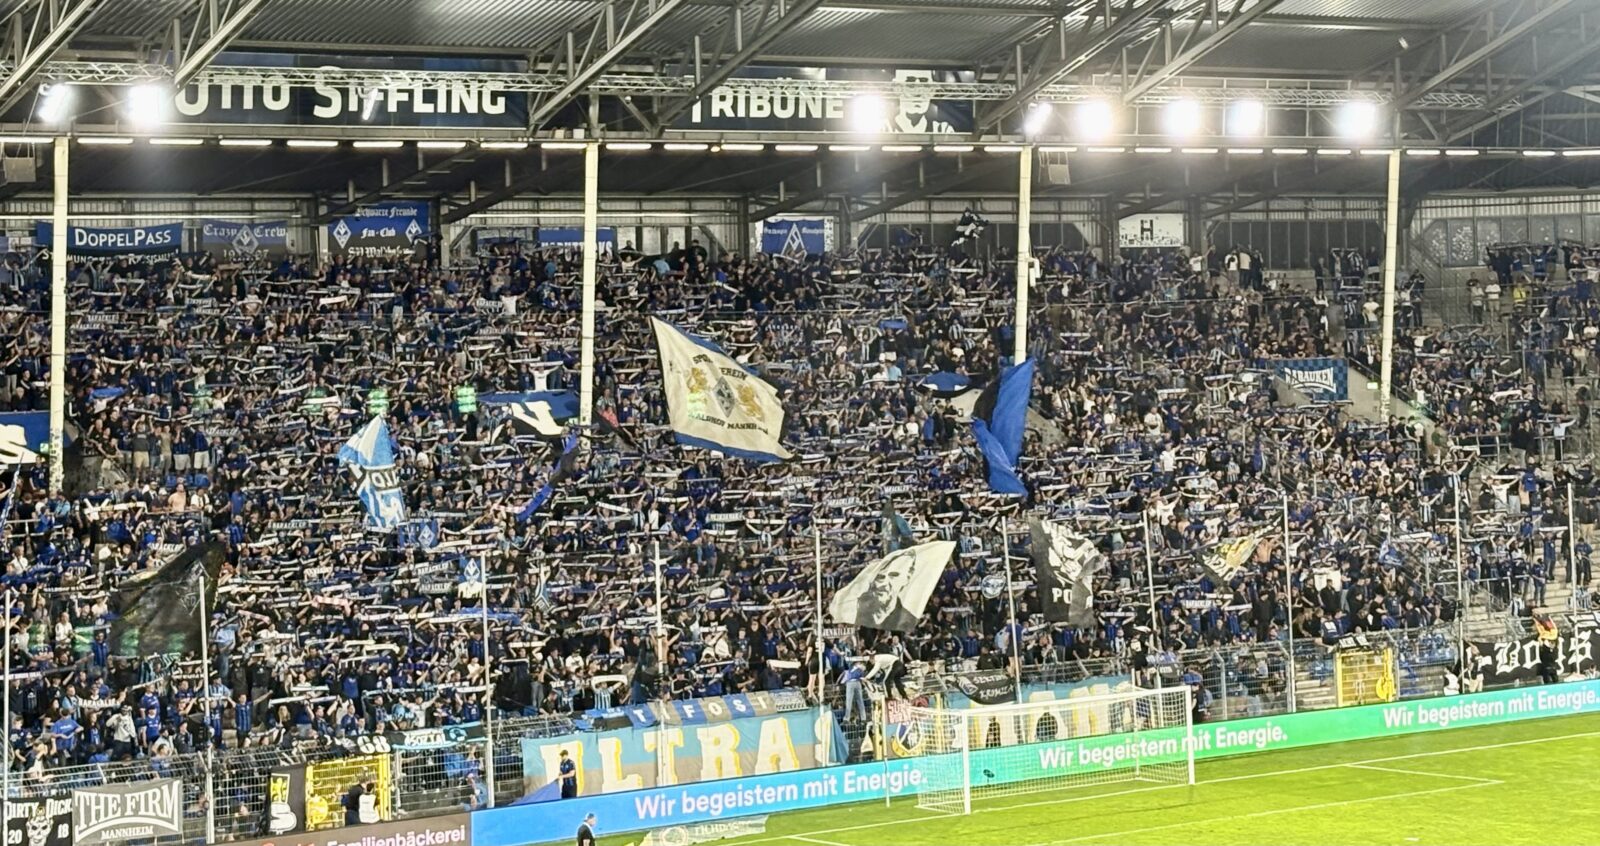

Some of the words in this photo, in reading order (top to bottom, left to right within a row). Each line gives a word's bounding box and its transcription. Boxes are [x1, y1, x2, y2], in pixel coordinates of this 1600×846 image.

[174, 74, 290, 116] OTTO
[203, 224, 238, 240] Crazy
[254, 225, 286, 238] Crew
[1384, 707, 1415, 729] Wir
[1418, 698, 1504, 727] begeistern
[1508, 693, 1535, 711] mit
[1537, 687, 1600, 711] Energie.
[357, 735, 391, 754] 68
[1039, 744, 1074, 769] Wir
[1079, 736, 1178, 768] begeistern
[1182, 731, 1211, 752] mit
[1215, 720, 1289, 748] Energie.
[75, 789, 121, 830] THE
[125, 780, 180, 822] FIRM
[635, 795, 676, 821] Wir
[682, 783, 798, 817] begeistern
[804, 773, 839, 799] mit
[843, 764, 927, 793] Energie.
[8, 829, 23, 844] 20
[58, 823, 70, 839] 18
[101, 825, 154, 841] MANNHEIM
